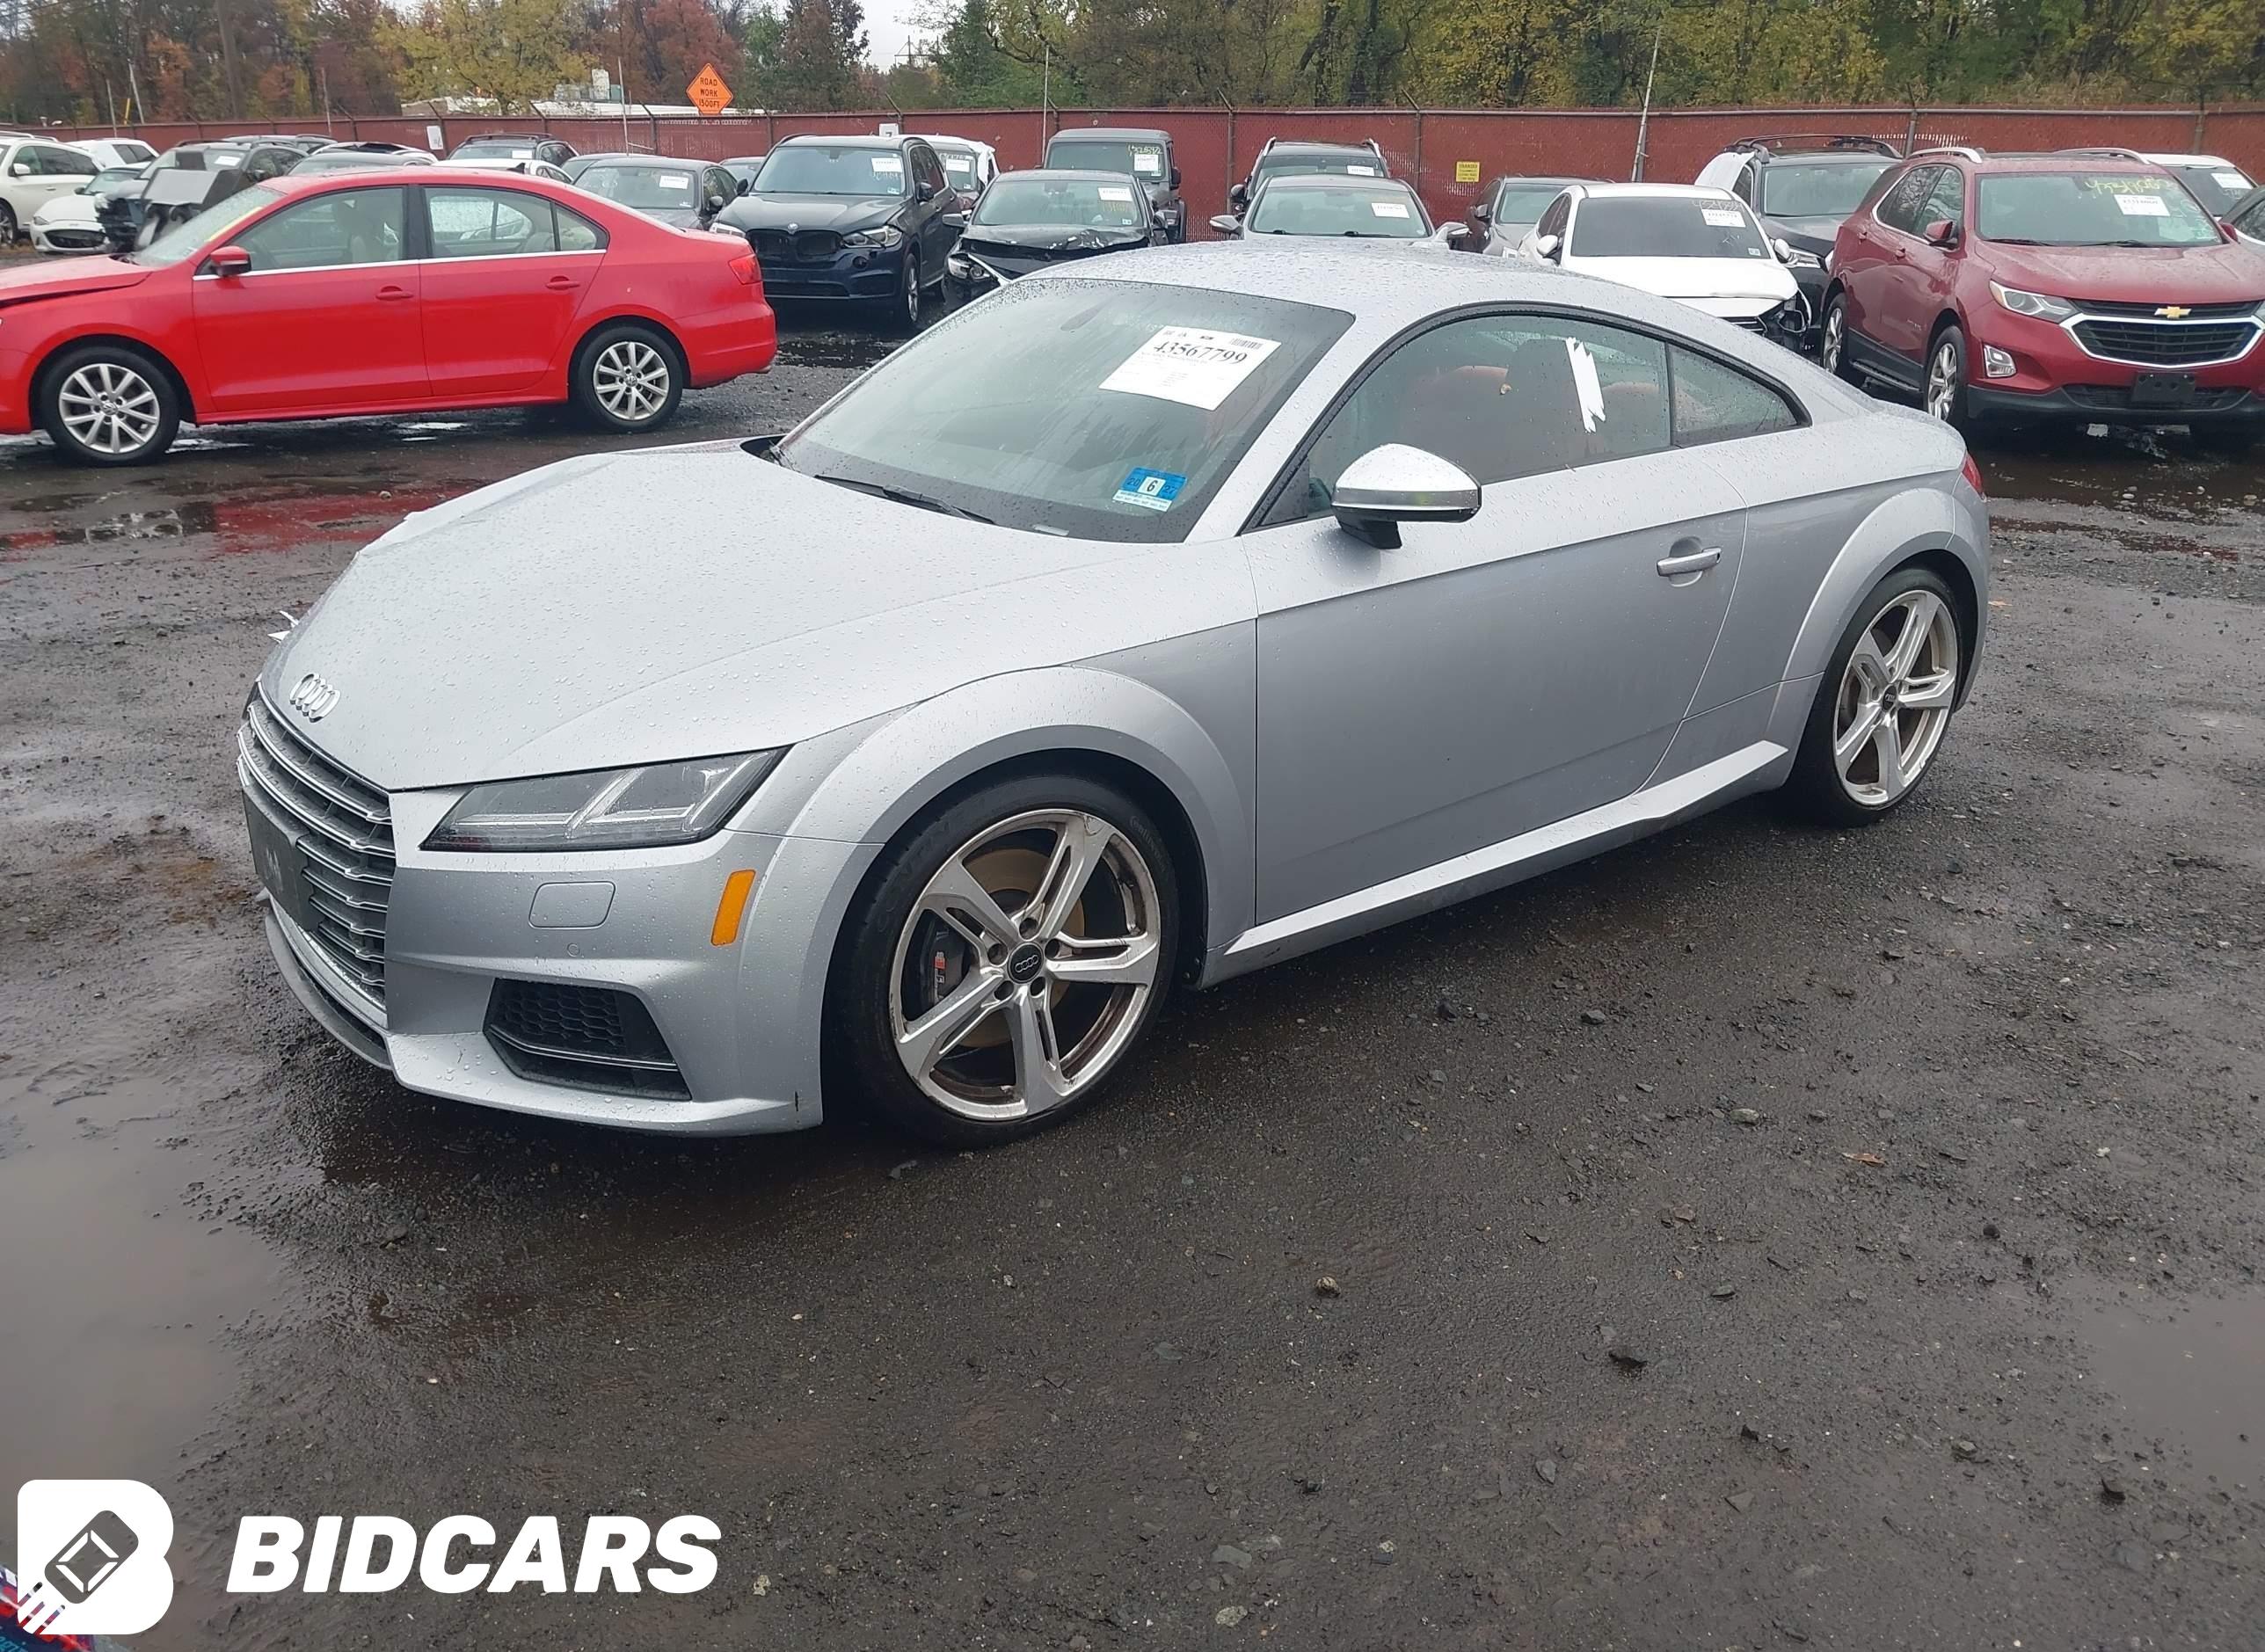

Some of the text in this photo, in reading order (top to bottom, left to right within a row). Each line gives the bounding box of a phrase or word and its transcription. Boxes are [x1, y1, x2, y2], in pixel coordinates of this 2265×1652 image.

[700, 77, 717, 86] ROAD
[1154, 341, 1248, 364] 43567799
[1147, 480, 1158, 492] 6
